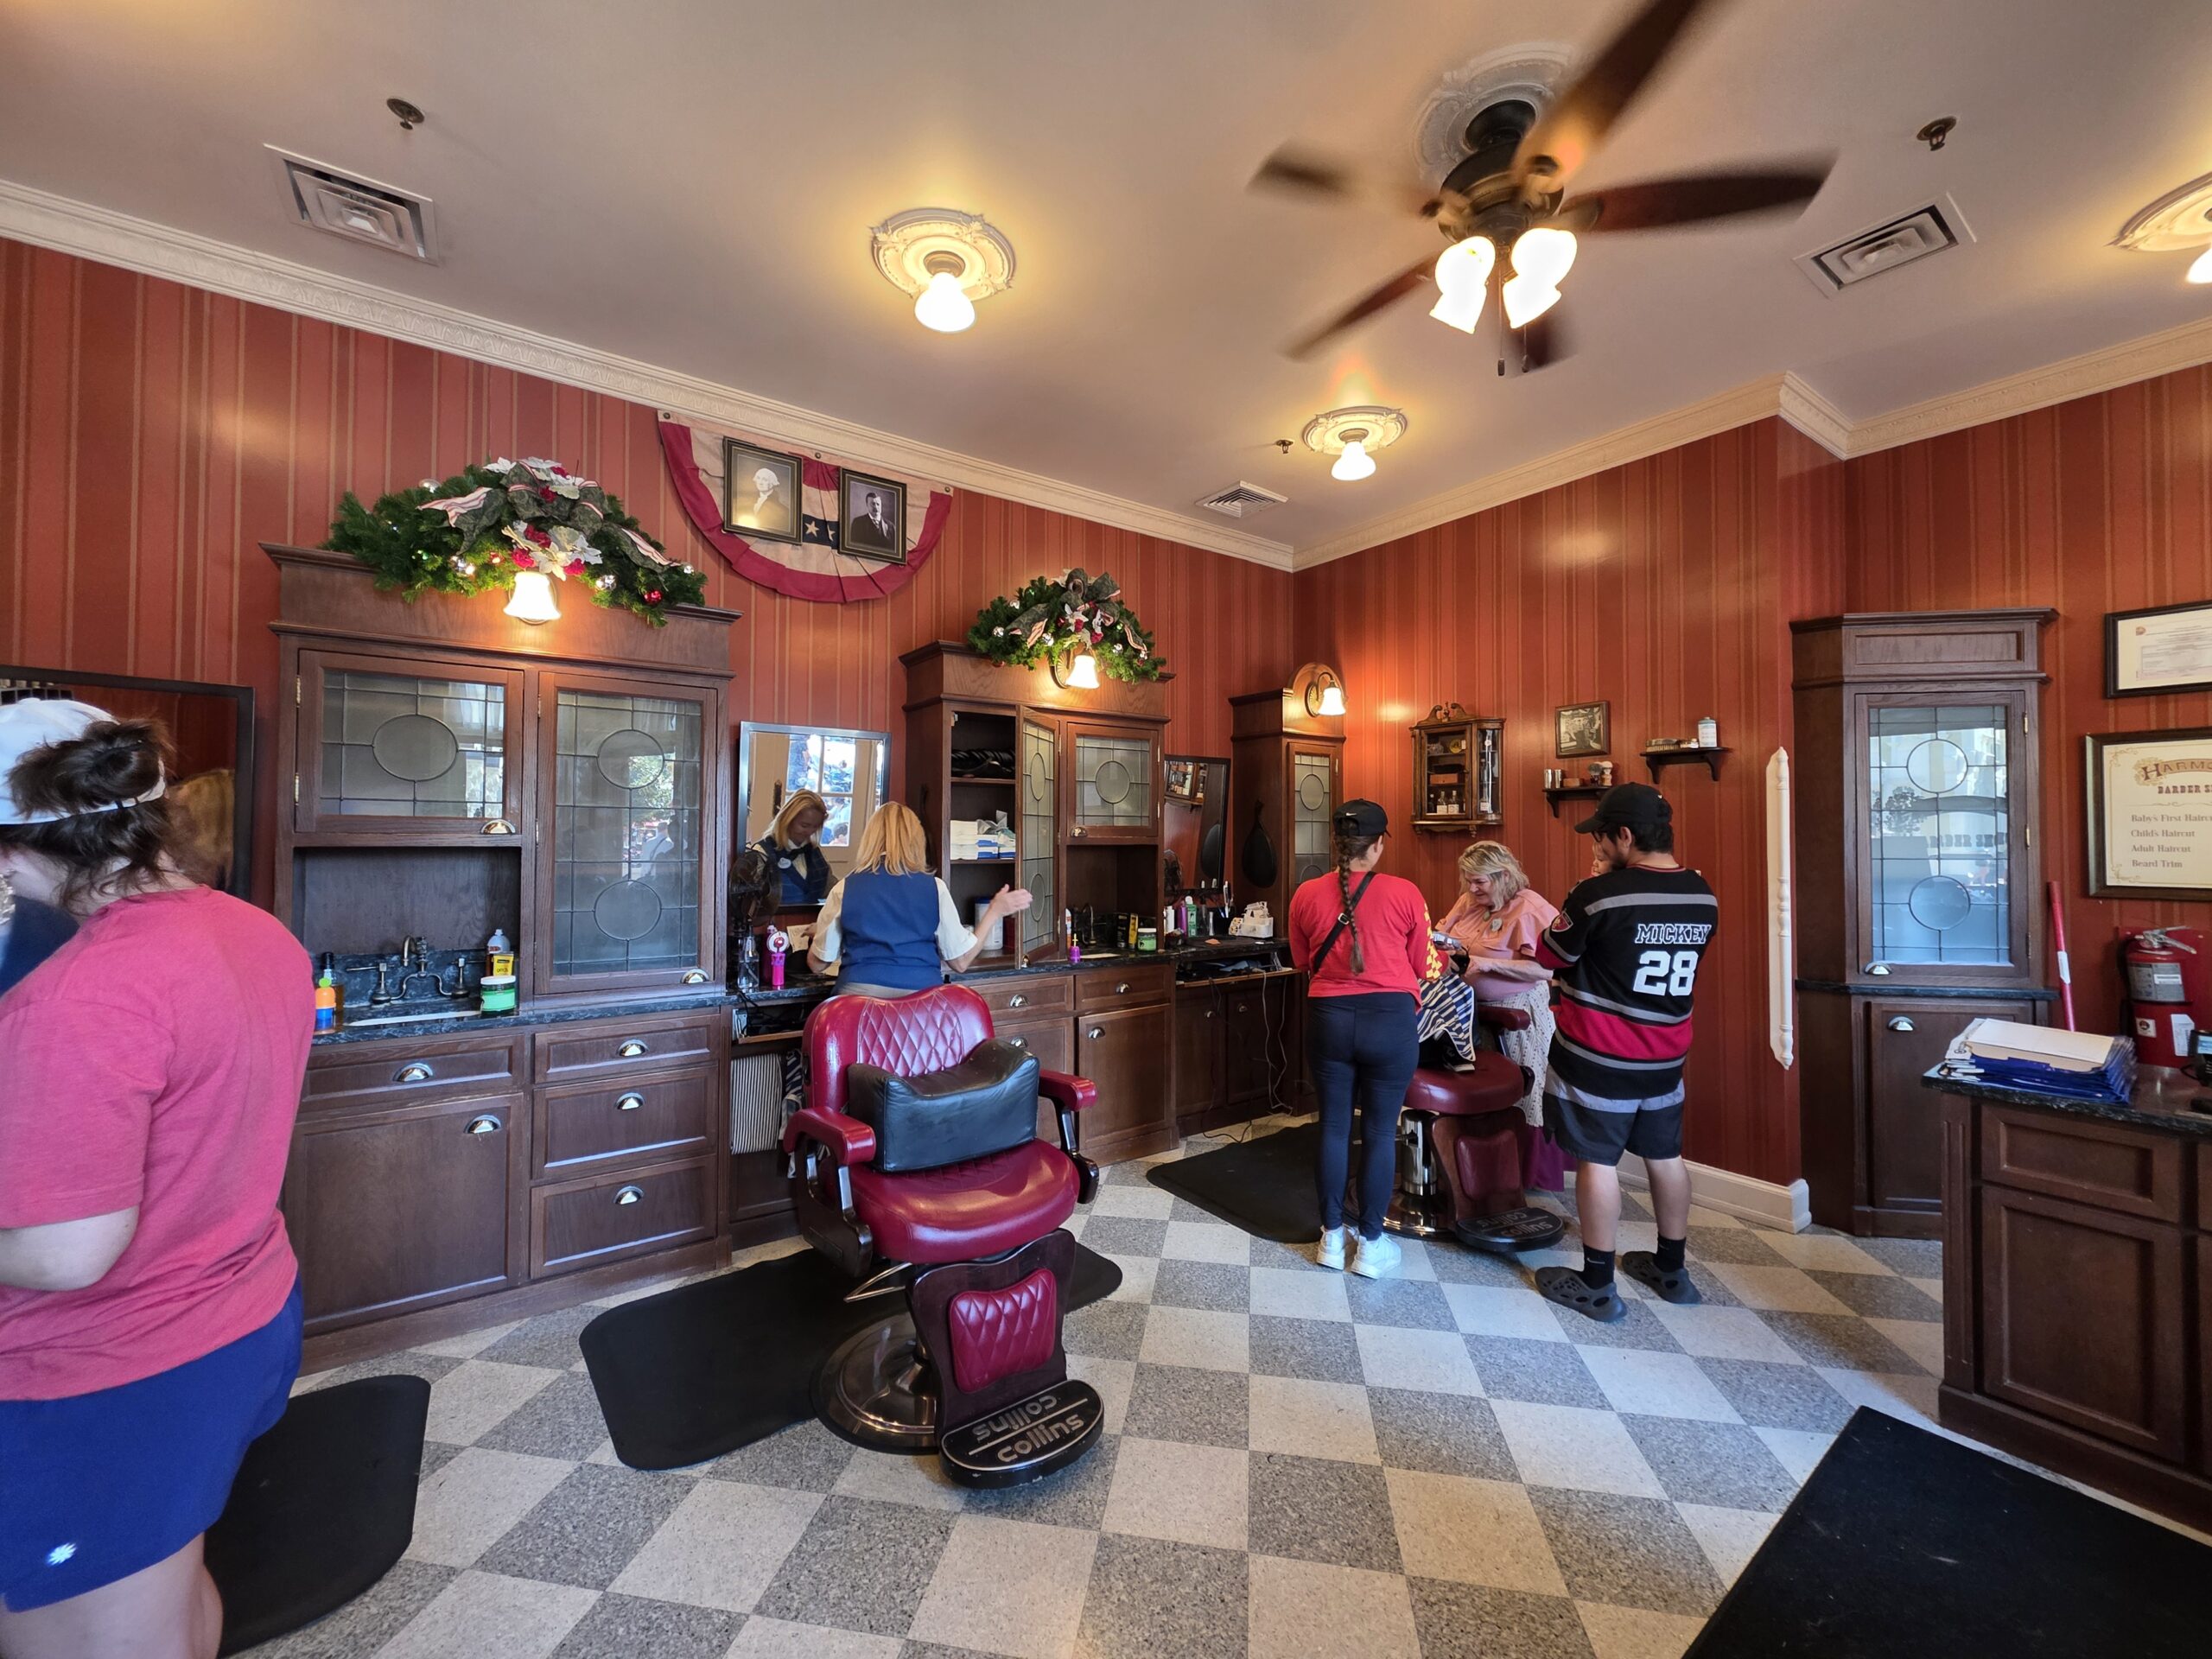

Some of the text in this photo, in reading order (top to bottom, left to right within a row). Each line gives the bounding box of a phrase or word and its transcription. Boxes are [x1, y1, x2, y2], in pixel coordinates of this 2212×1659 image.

[2158, 785, 2212, 794] BARBER S
[2131, 844, 2191, 853] Adult Haircut
[2132, 859, 2183, 868] Beard Trim
[1634, 924, 1712, 944] MICKEY
[1633, 950, 1699, 996] 28
[971, 1395, 1057, 1443] collins
[997, 1414, 1084, 1462] collins
